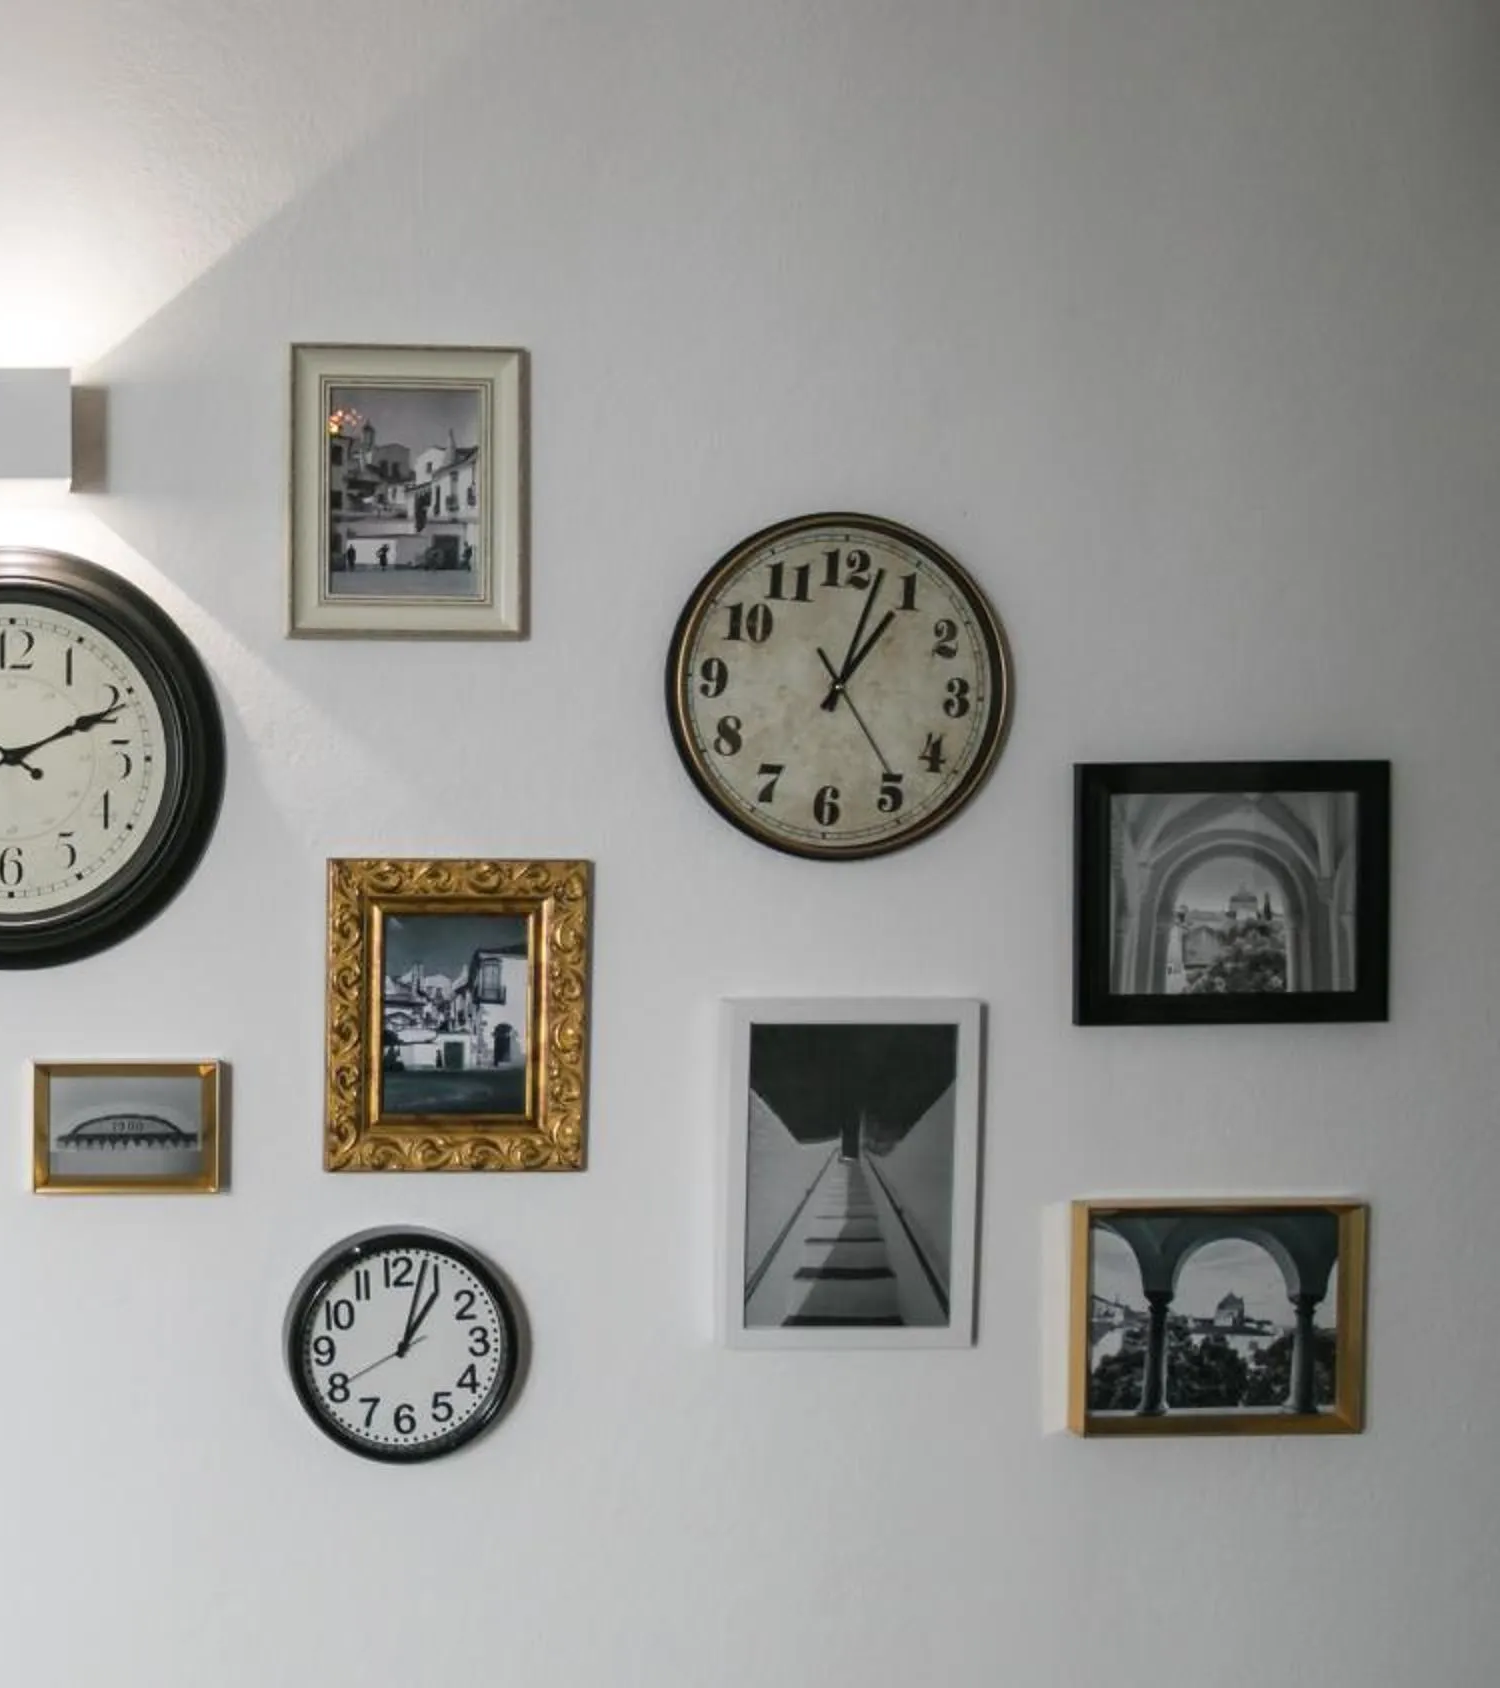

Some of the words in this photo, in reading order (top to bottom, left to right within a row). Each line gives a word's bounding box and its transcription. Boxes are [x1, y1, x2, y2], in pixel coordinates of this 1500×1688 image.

[765, 562, 815, 603] 11
[820, 548, 873, 591] 12
[898, 572, 920, 612] 1
[723, 602, 774, 644] 10
[932, 619, 959, 660] 2
[0, 629, 35, 670] 12
[66, 647, 73, 686] 1
[699, 657, 729, 698] 9
[100, 684, 120, 723] 2
[942, 677, 970, 718] 3
[713, 715, 743, 757] 8
[918, 732, 947, 774] 4
[757, 763, 786, 803] 7
[876, 773, 904, 814] 5
[813, 785, 841, 827] 6
[0, 846, 24, 887] 6
[56, 831, 77, 869] 5
[355, 1269, 371, 1301] 11
[384, 1257, 416, 1289] 12
[433, 1263, 440, 1295] 1
[325, 1299, 355, 1331] 10
[453, 1289, 477, 1321] 2
[313, 1335, 336, 1367] 9
[468, 1325, 491, 1357] 3
[327, 1372, 351, 1404] 8
[456, 1363, 481, 1395] 4
[358, 1397, 381, 1428] 7
[393, 1403, 417, 1435] 6
[431, 1391, 455, 1423] 5
